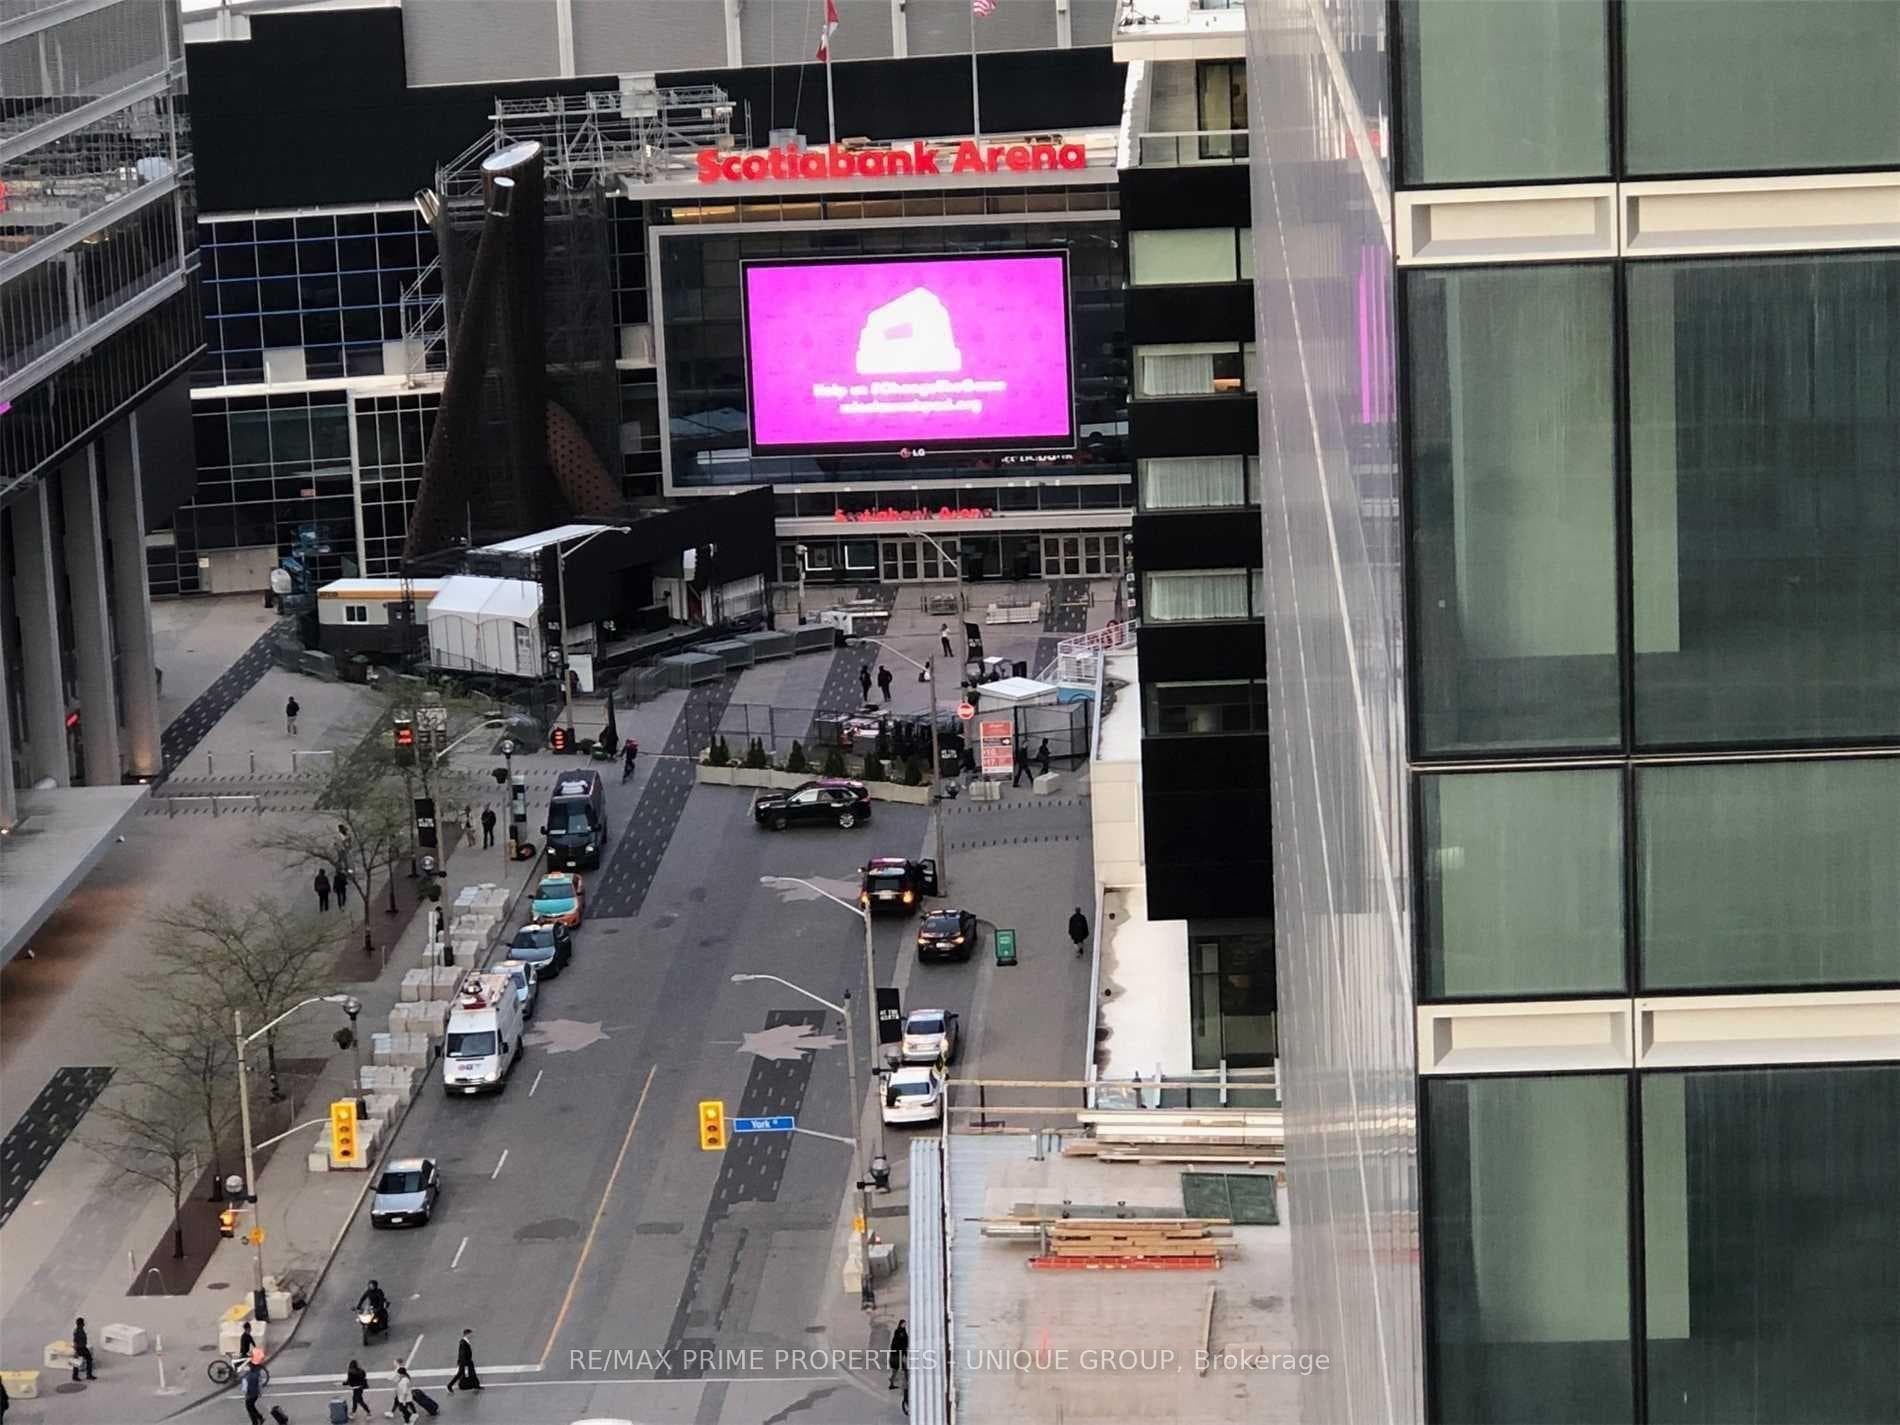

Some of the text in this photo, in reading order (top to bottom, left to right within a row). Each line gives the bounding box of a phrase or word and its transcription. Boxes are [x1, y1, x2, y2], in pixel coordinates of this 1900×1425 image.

[697, 140, 1087, 184] Scotiabank Arena
[912, 448, 925, 457] LG
[939, 506, 993, 520] Arena
[751, 1119, 770, 1129] York
